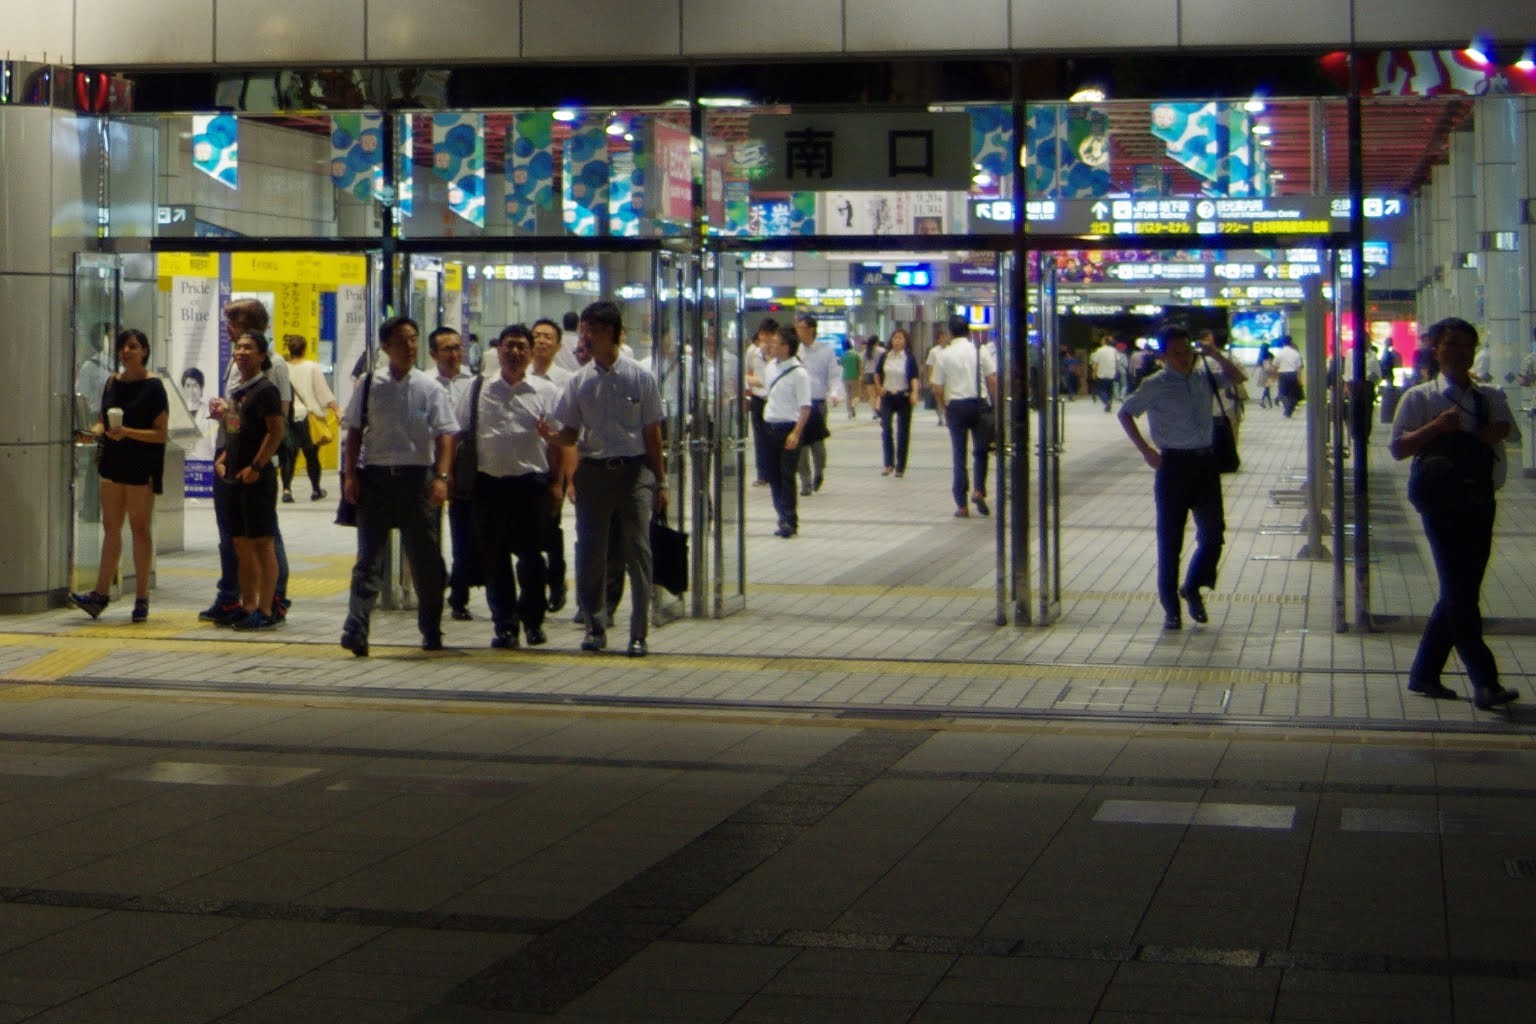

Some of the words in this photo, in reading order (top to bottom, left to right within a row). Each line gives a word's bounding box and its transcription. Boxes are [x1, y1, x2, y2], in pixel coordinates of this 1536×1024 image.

[784, 128, 934, 179] 南口
[181, 281, 211, 295] Pride
[181, 308, 210, 322] Blue
